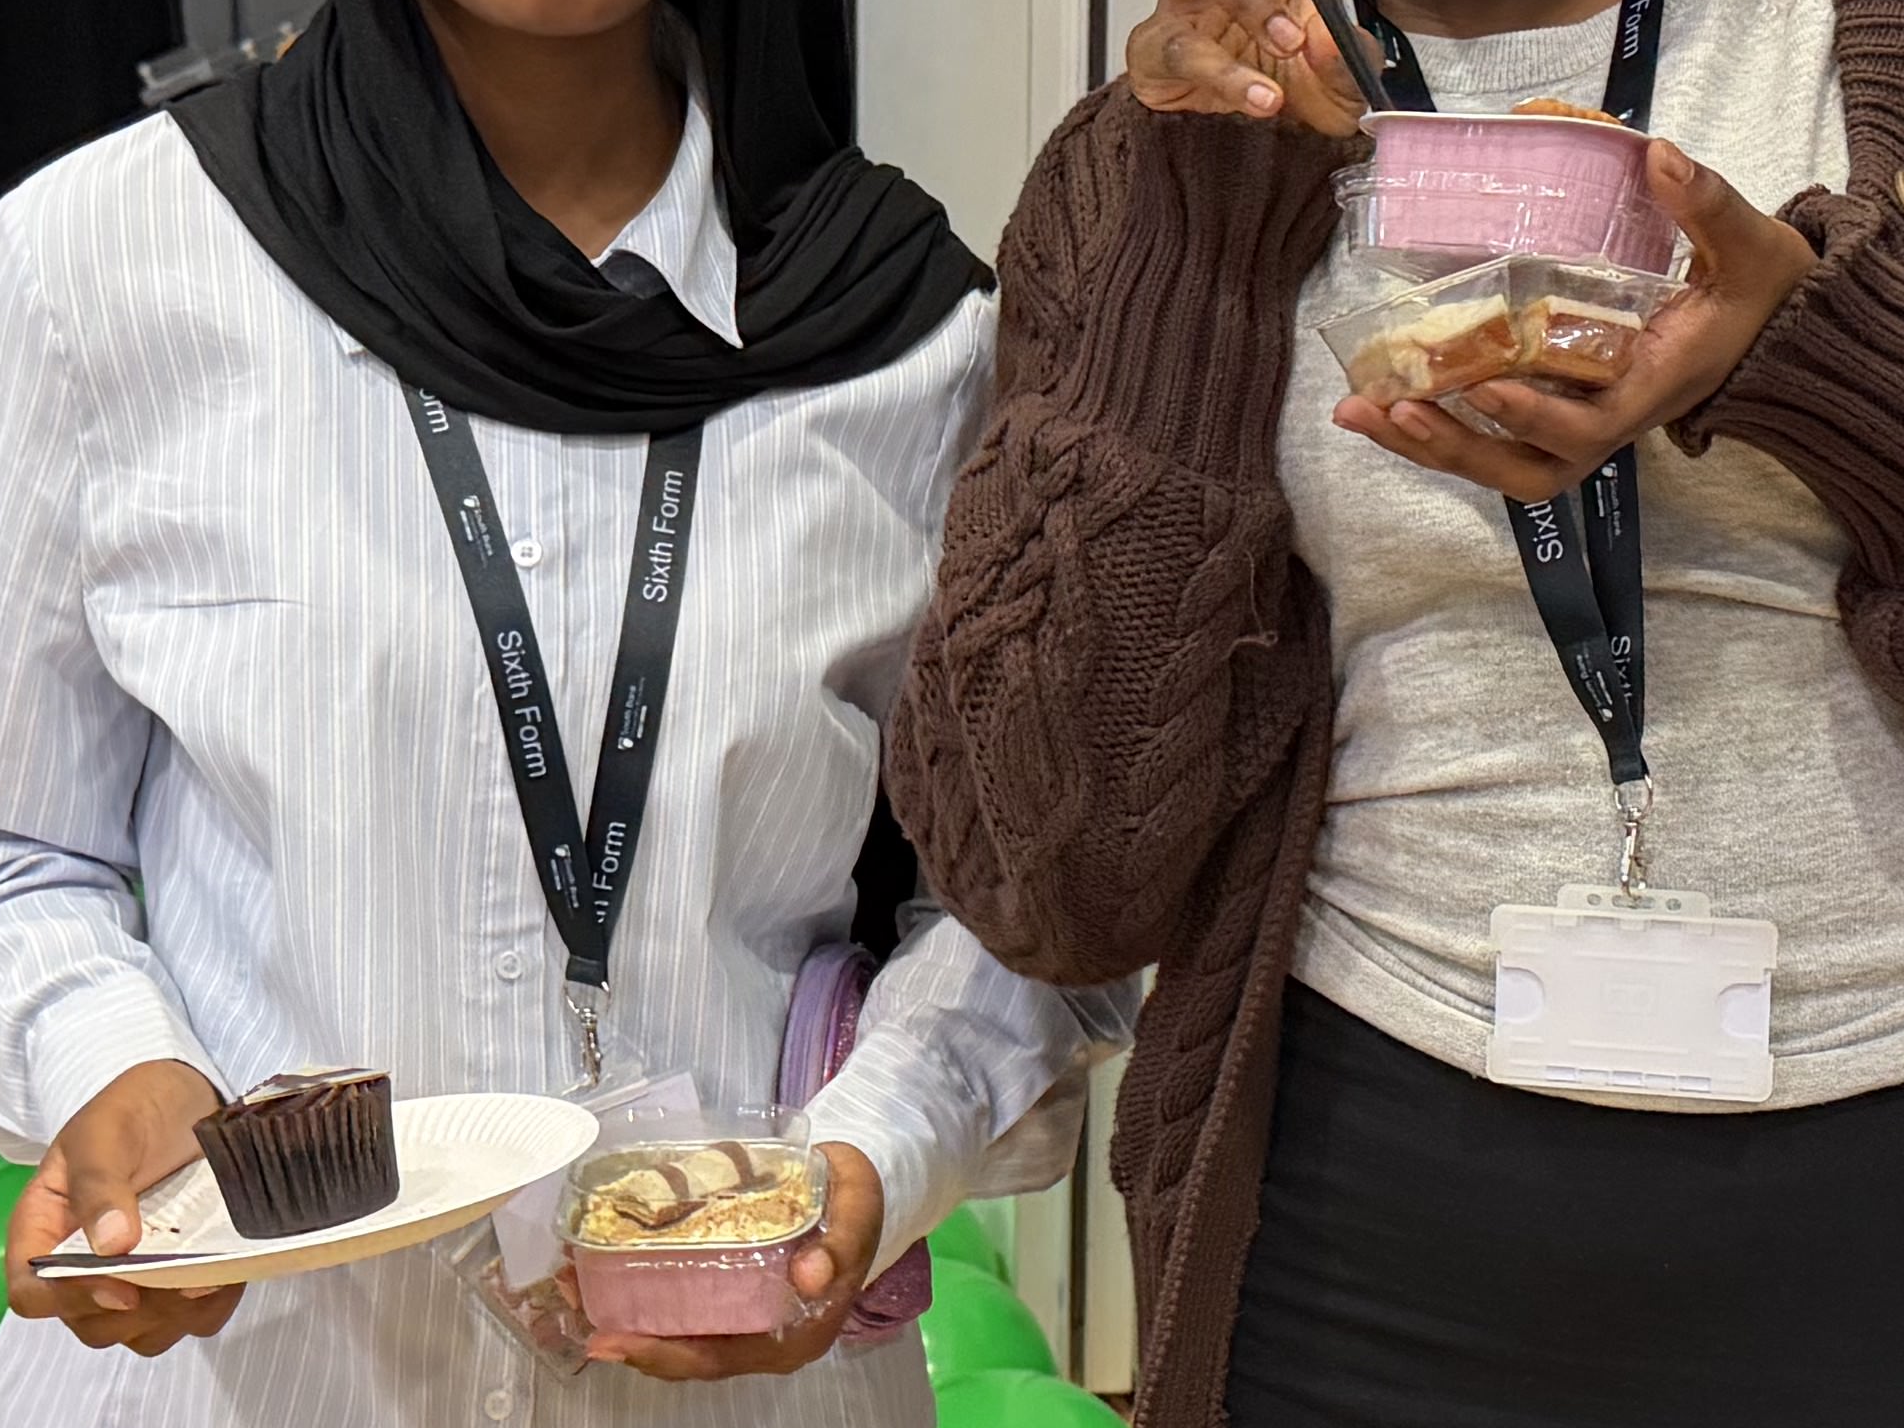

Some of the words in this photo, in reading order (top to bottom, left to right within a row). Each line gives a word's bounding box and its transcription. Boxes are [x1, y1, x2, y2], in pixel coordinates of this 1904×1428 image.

[652, 470, 684, 535] Form
[642, 541, 674, 603] Sixth
[497, 630, 533, 699] Sixth
[514, 705, 547, 778] Form
[592, 821, 627, 891] Form
